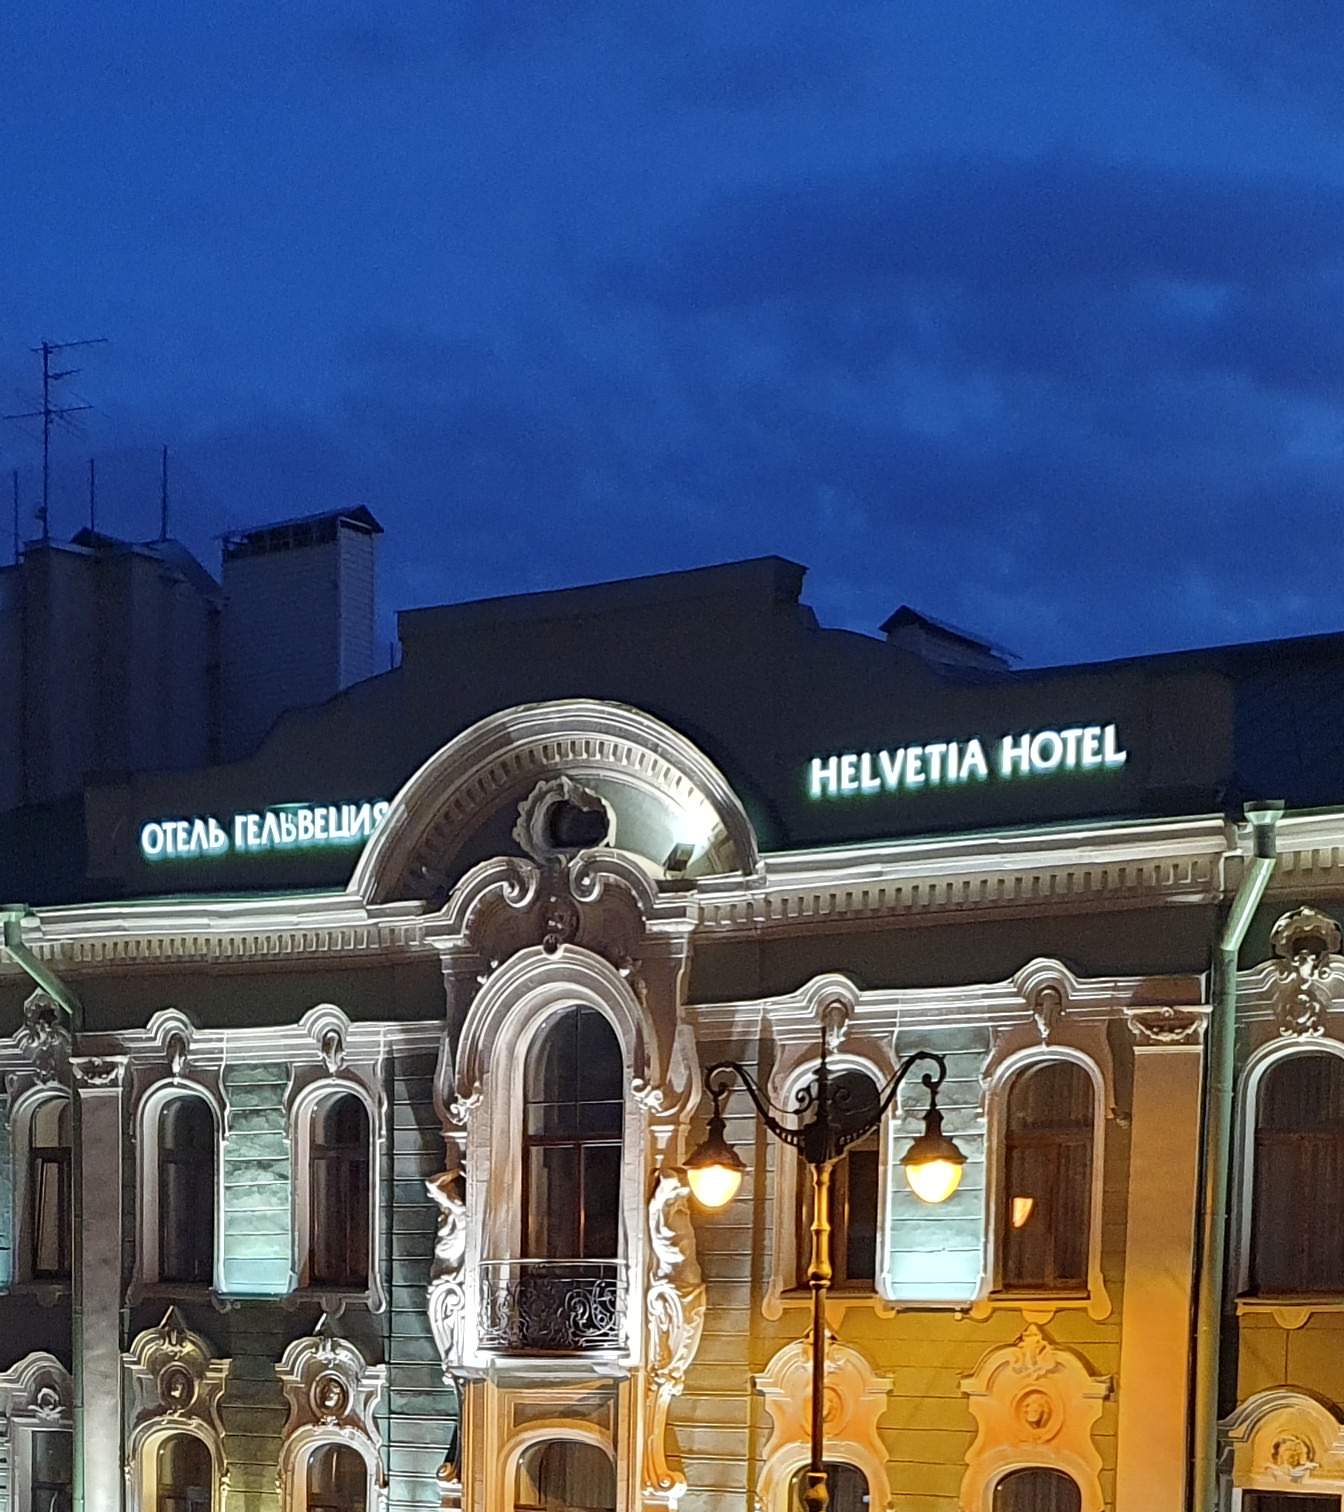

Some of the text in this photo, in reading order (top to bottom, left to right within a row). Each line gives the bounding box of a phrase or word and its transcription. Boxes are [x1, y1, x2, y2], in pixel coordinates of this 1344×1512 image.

[810, 724, 1127, 797] HELVETIA HOTEL
[141, 800, 390, 855] ОТЕЛЬ ГЕЛЬВЕЦИЯ
